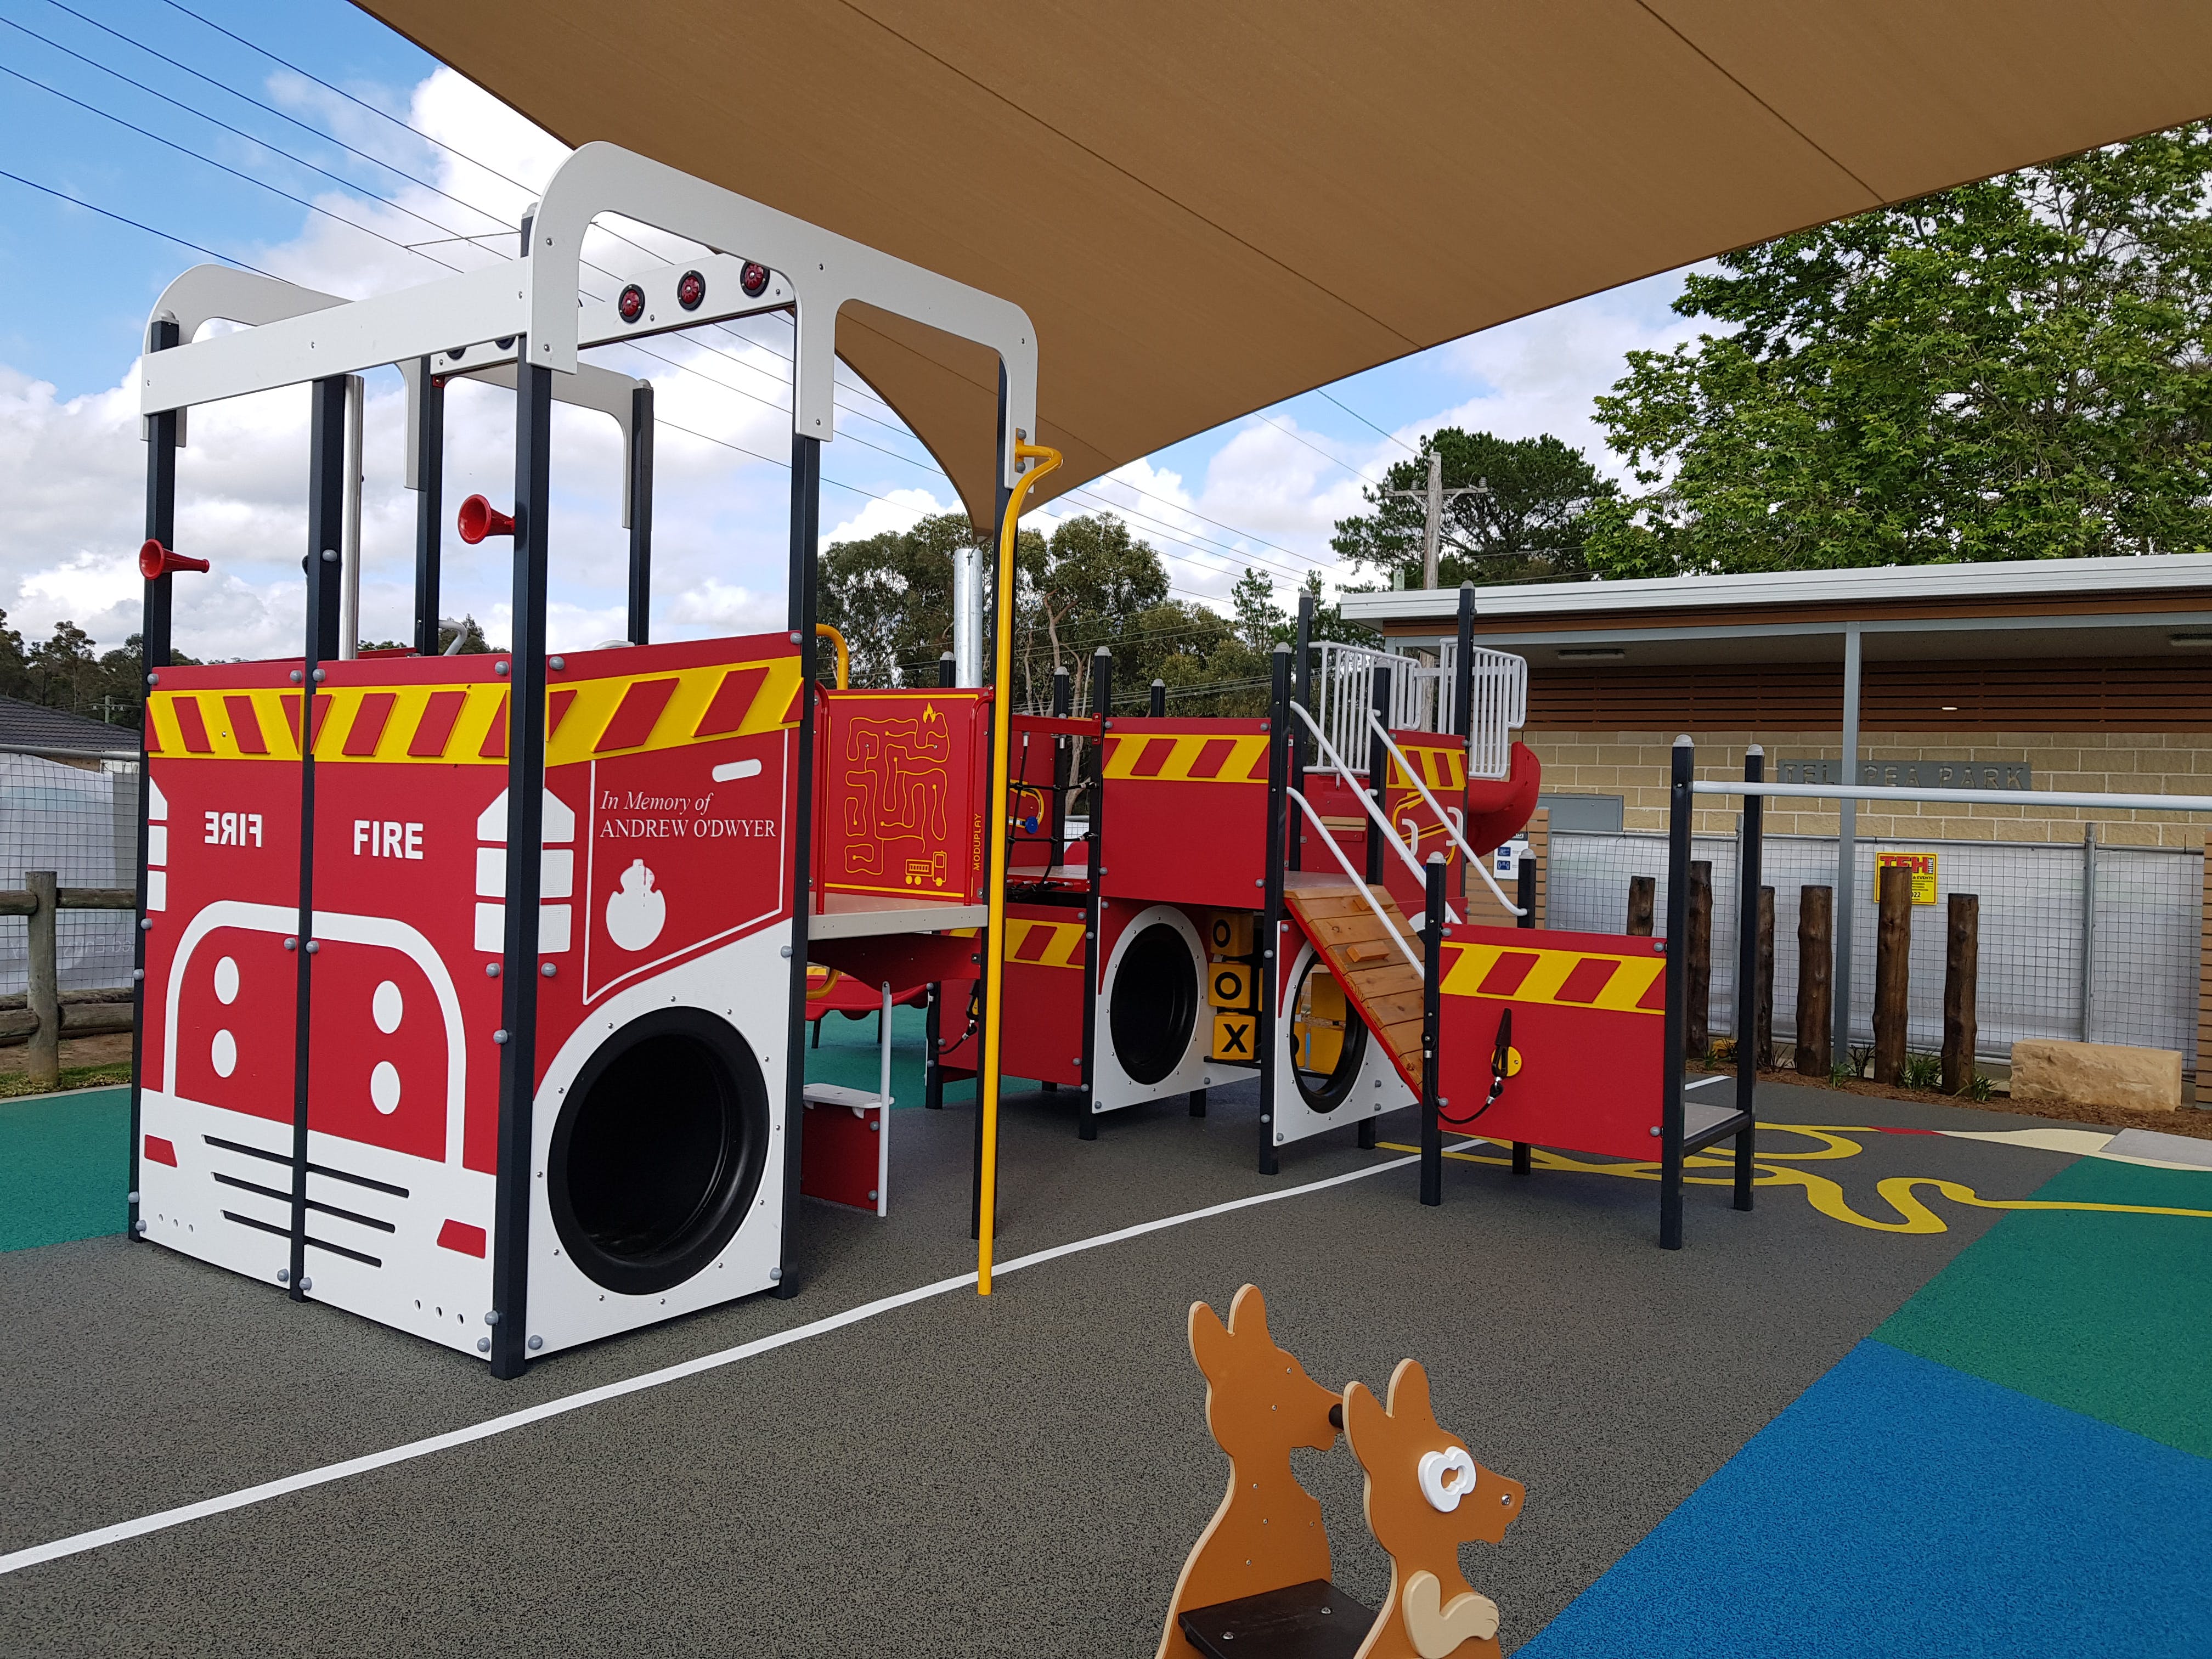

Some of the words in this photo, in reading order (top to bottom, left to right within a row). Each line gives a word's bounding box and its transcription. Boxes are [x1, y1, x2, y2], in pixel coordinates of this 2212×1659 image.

[1784, 764, 1921, 787] TELPEA
[1939, 766, 2023, 790] PARK
[600, 791, 618, 810] In
[623, 791, 691, 815] Memory
[695, 792, 714, 816] of
[354, 820, 424, 860] FIRE
[600, 819, 689, 838] ANDREW
[694, 820, 776, 837] O'DWYER
[973, 814, 981, 871] MODUPLAY
